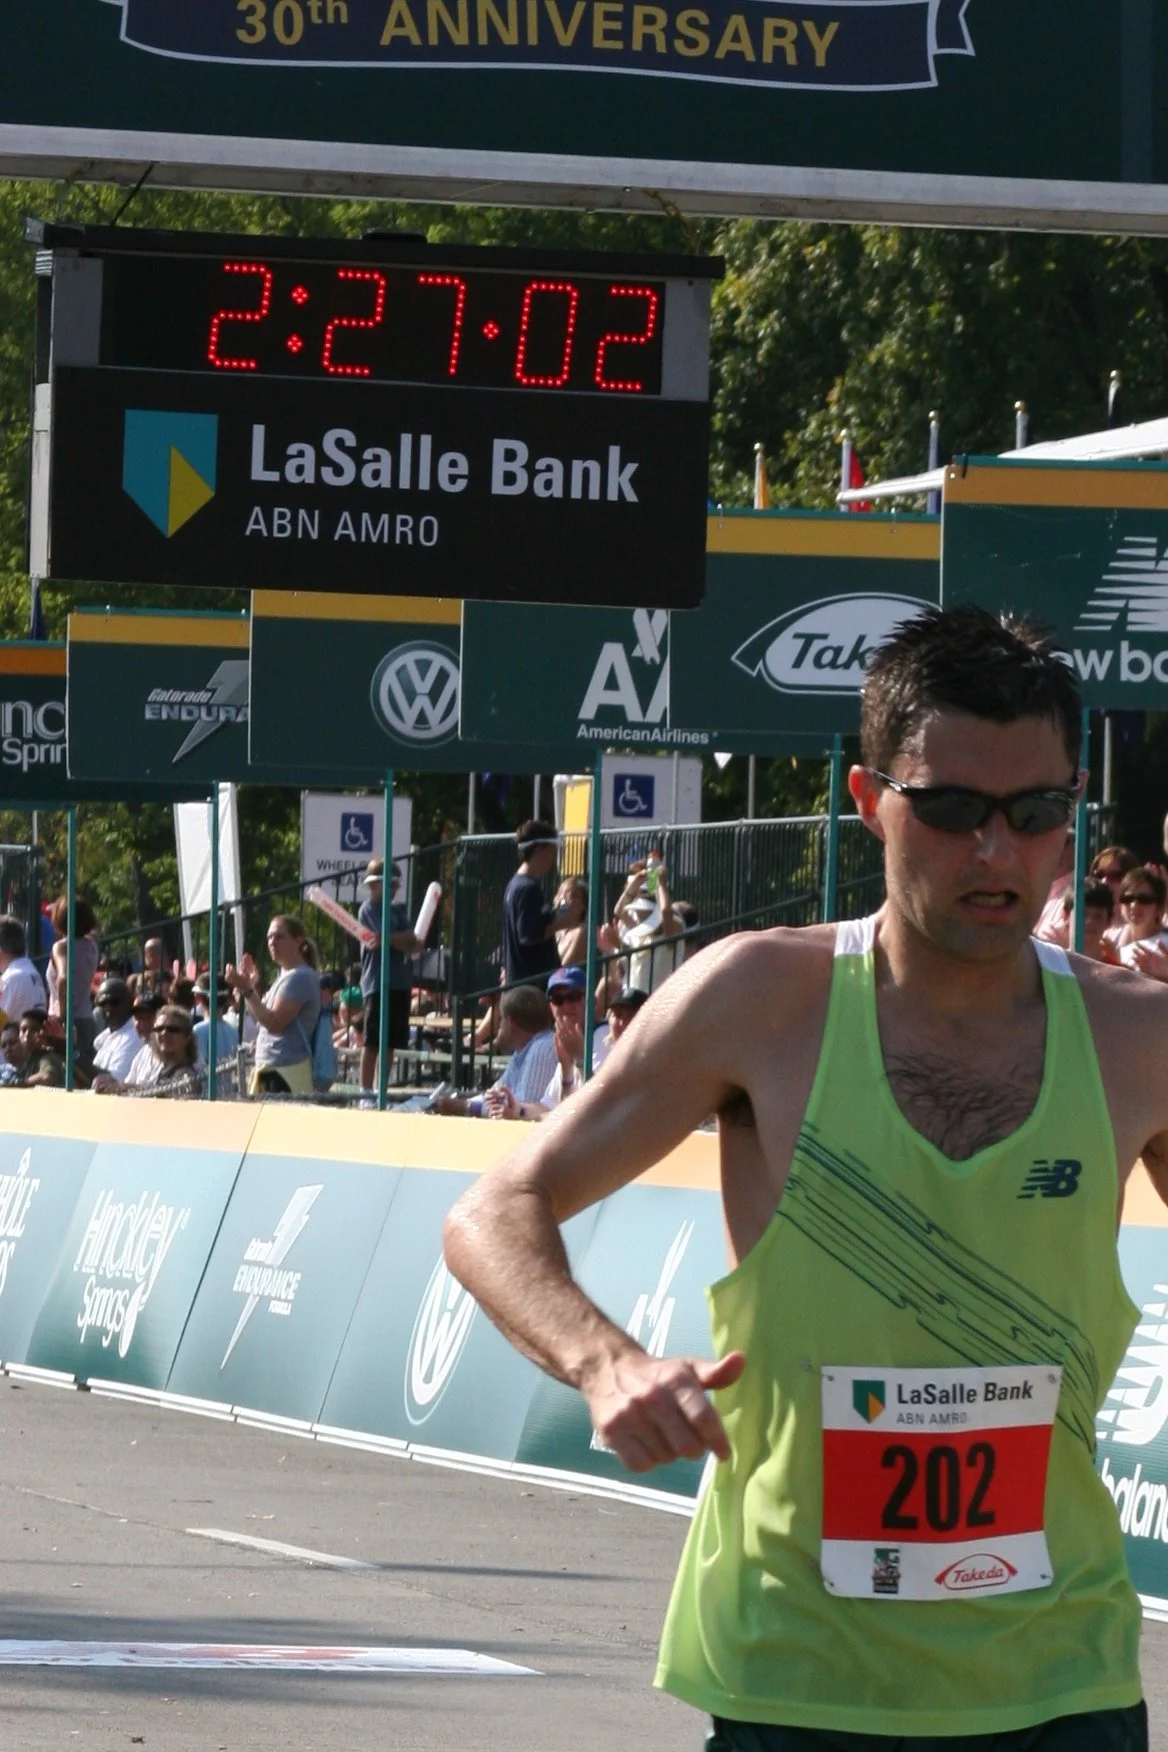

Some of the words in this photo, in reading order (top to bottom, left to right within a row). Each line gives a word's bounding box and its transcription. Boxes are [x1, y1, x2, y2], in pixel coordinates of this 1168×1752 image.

[236, 0, 348, 44] 30th
[379, 0, 840, 68] ANNIVERSARY
[251, 424, 469, 493] LaSalle
[491, 438, 639, 503] Bank
[245, 506, 320, 540] ABN
[333, 511, 439, 547] AMRO
[791, 632, 878, 671] Tak
[145, 703, 250, 723] ENDURA
[576, 724, 709, 745] AmericanAirlines
[73, 1189, 175, 1311] Hinckley
[233, 1265, 301, 1299] ENDURANCE
[77, 1275, 132, 1348] Springs
[897, 1382, 977, 1404] LaSalle
[984, 1380, 1034, 1402] Bank
[896, 1412, 924, 1424] ABN
[928, 1412, 968, 1424] AMRO
[880, 1441, 996, 1533] 202
[953, 1565, 1004, 1584] Takeda
